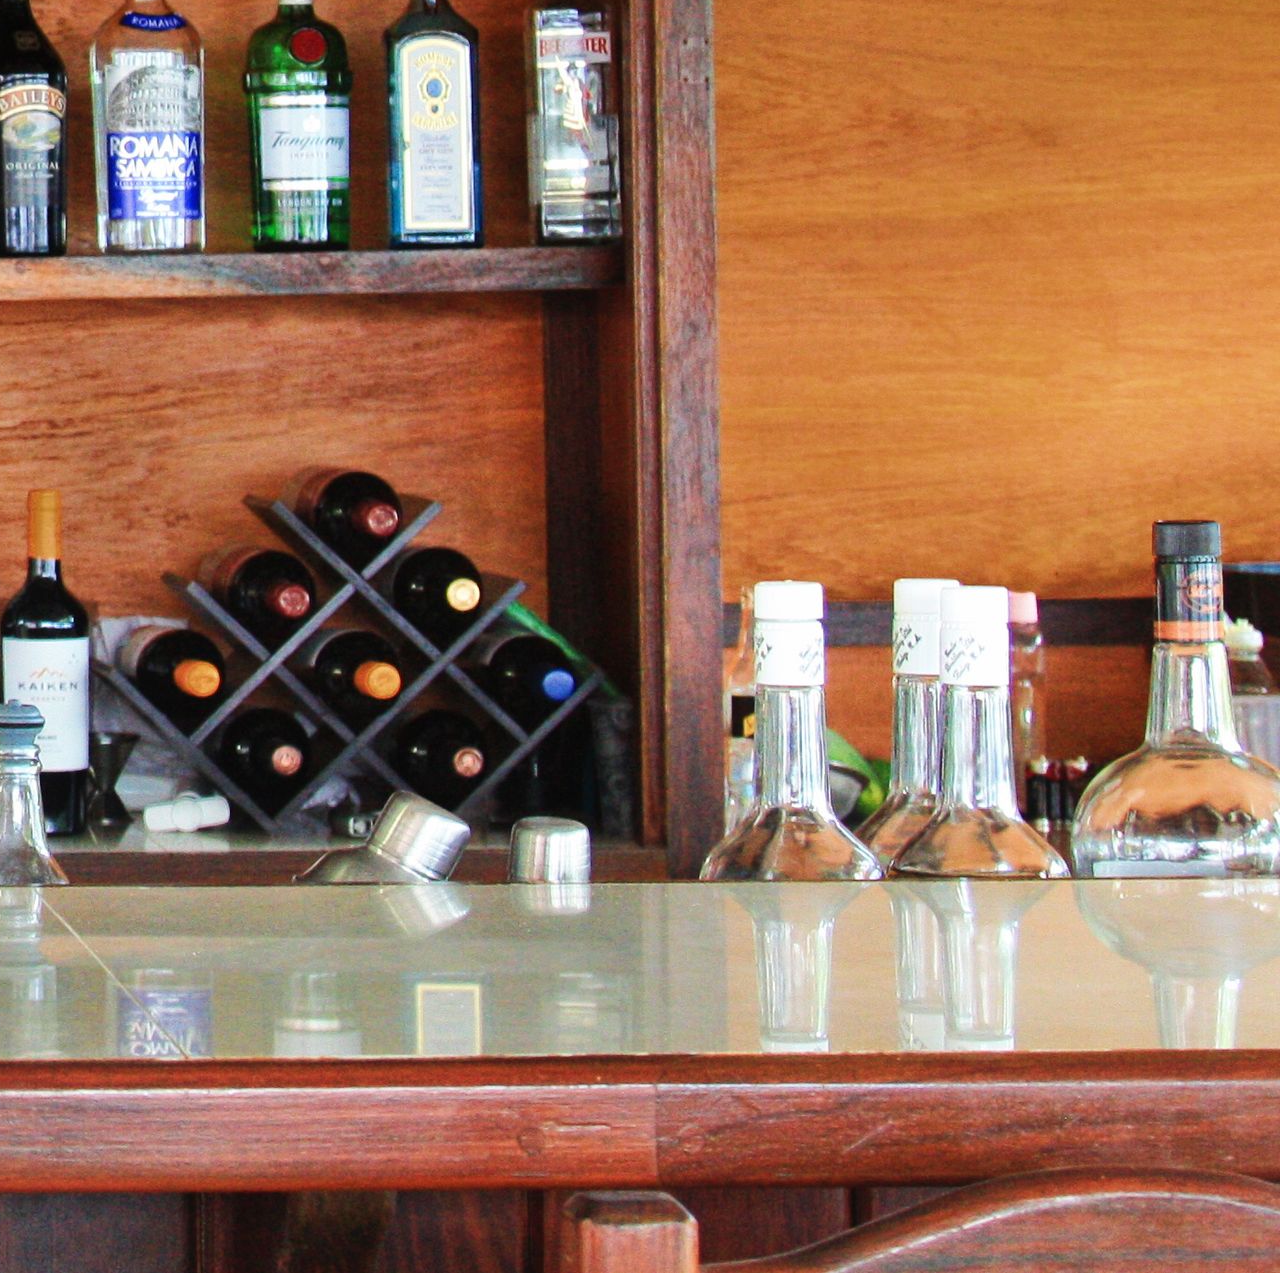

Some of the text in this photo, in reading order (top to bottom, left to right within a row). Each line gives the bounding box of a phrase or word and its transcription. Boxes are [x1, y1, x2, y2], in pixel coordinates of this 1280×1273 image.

[541, 37, 608, 59] BEETER
[109, 133, 199, 159] ROMANA
[272, 131, 346, 151] Tanqueray
[6, 161, 59, 170] ORIGINAL
[18, 681, 79, 691] KAIKEN
